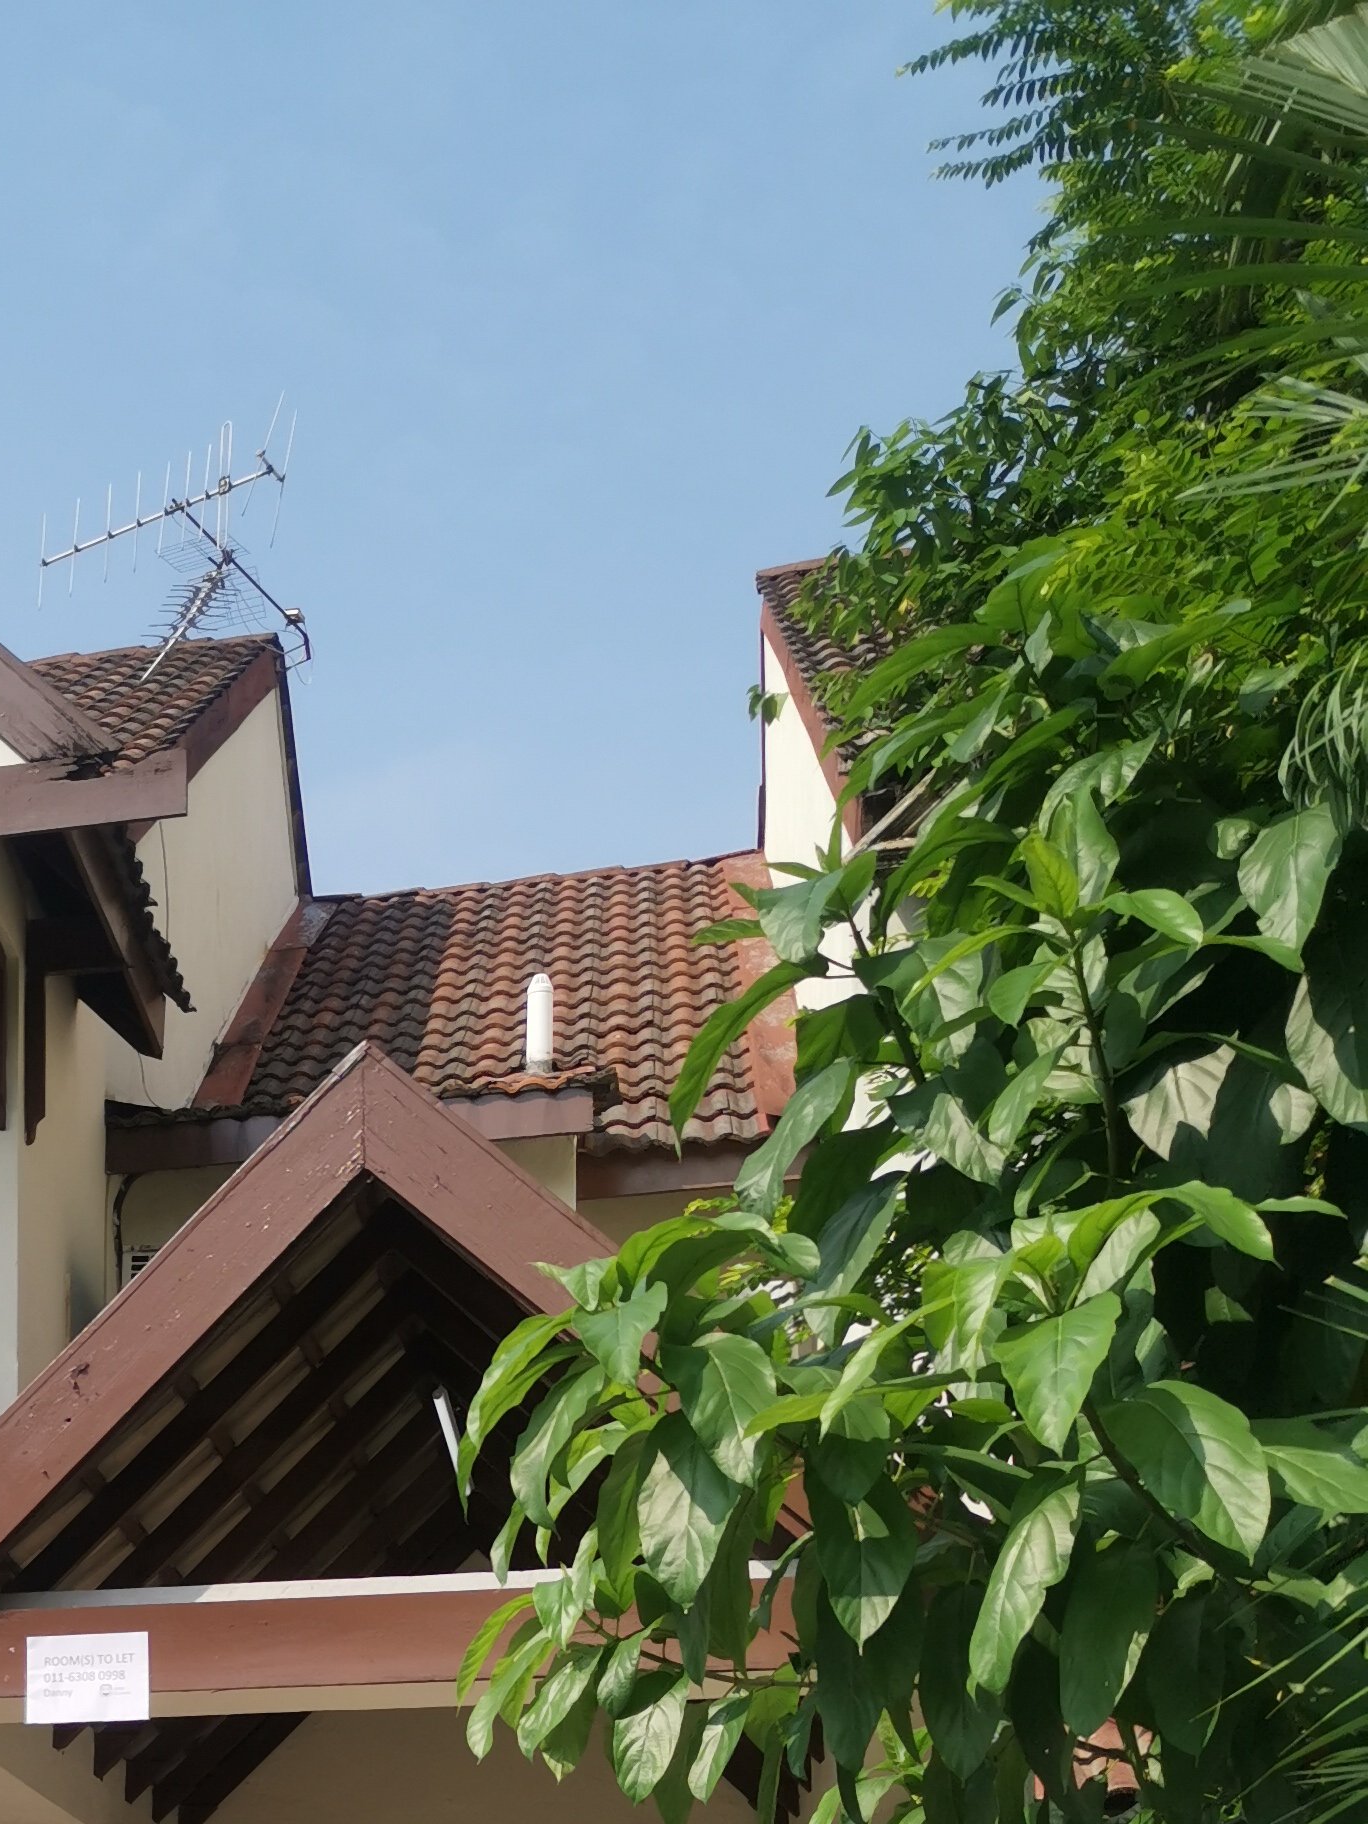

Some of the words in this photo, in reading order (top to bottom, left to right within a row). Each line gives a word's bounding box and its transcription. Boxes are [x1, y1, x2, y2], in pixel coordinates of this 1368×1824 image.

[43, 1654, 95, 1668] ROOM(S)
[97, 1653, 114, 1665] TO
[115, 1652, 135, 1664] LET
[43, 1671, 96, 1683] 011-6308
[97, 1669, 126, 1681] 0998
[43, 1688, 73, 1698] Danny
